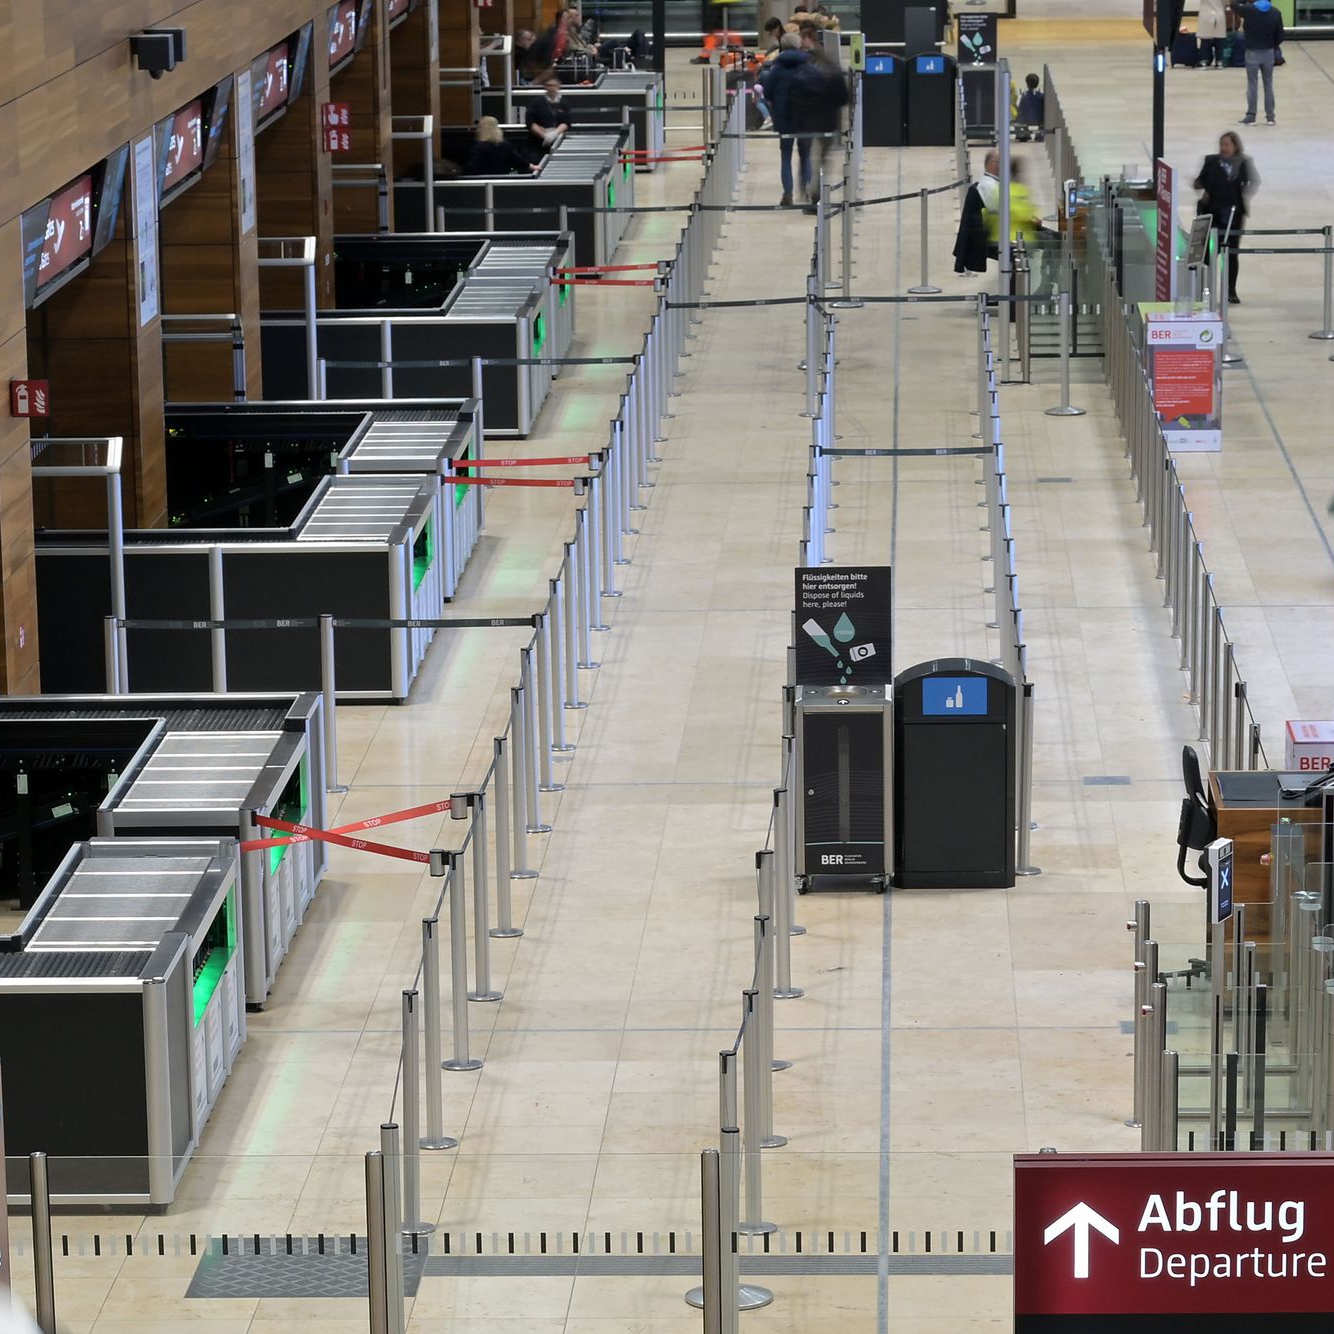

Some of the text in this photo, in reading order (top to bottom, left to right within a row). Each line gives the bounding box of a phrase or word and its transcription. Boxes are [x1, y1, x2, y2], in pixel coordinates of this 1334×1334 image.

[1151, 330, 1171, 339] BER
[802, 574, 849, 582] Flüssigkeiten
[818, 582, 857, 591] entsorgen!
[802, 592, 830, 600] Dispose
[840, 591, 865, 600] liquids
[822, 601, 847, 609] please!
[1300, 757, 1331, 770] BER
[436, 801, 451, 811] STO
[362, 818, 382, 828] STOP
[292, 825, 308, 833] STOP
[351, 840, 368, 849] STOP
[413, 852, 429, 861] STOP
[821, 854, 844, 865] BER
[1138, 1190, 1305, 1242] Abflug
[1141, 1245, 1327, 1287] Departure
